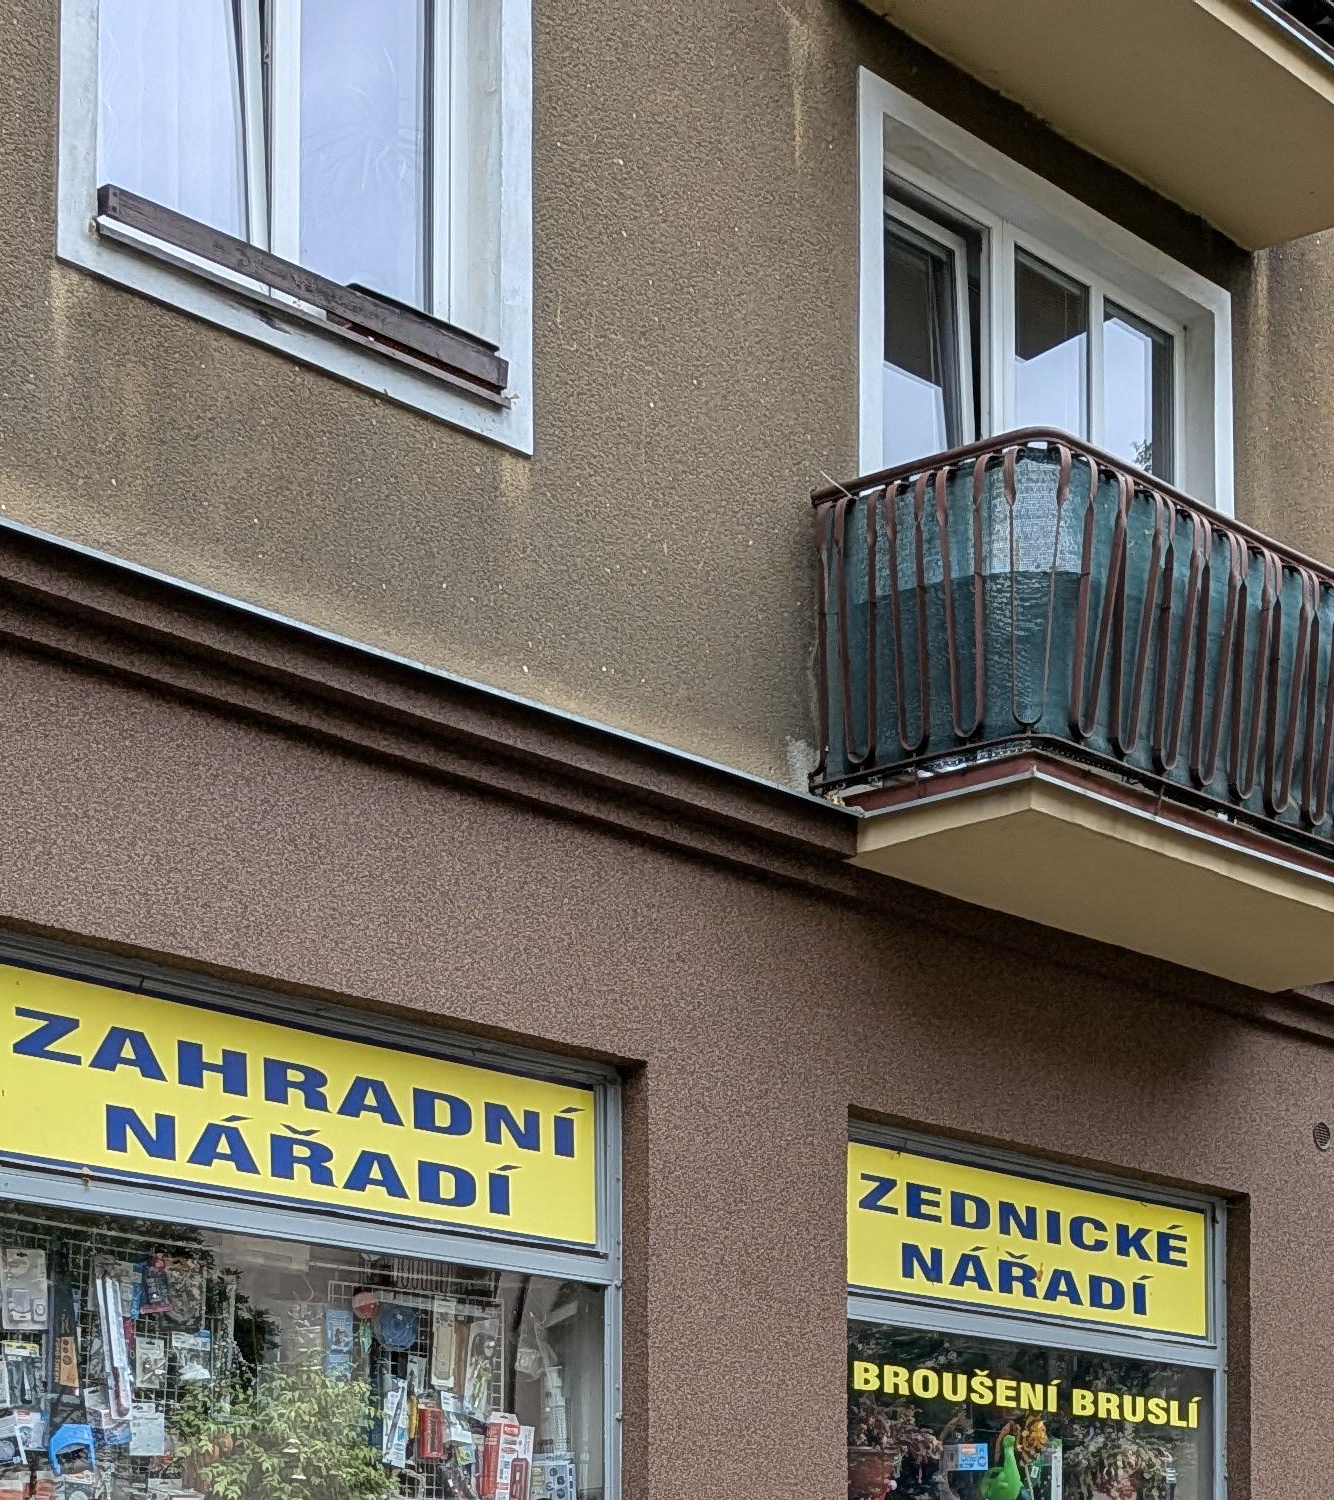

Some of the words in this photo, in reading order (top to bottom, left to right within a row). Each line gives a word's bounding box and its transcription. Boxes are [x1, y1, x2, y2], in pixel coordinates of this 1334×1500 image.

[12, 1007, 586, 1159] ZAHRADNÍ
[106, 1104, 521, 1216] NÁŘADÍ
[859, 1173, 1188, 1267] ZEDNICKÉ
[901, 1242, 1154, 1316] NÁŘADÍ
[853, 1361, 1063, 1413] BROUŠENÍ
[1072, 1388, 1202, 1429] BRUSLÍ
